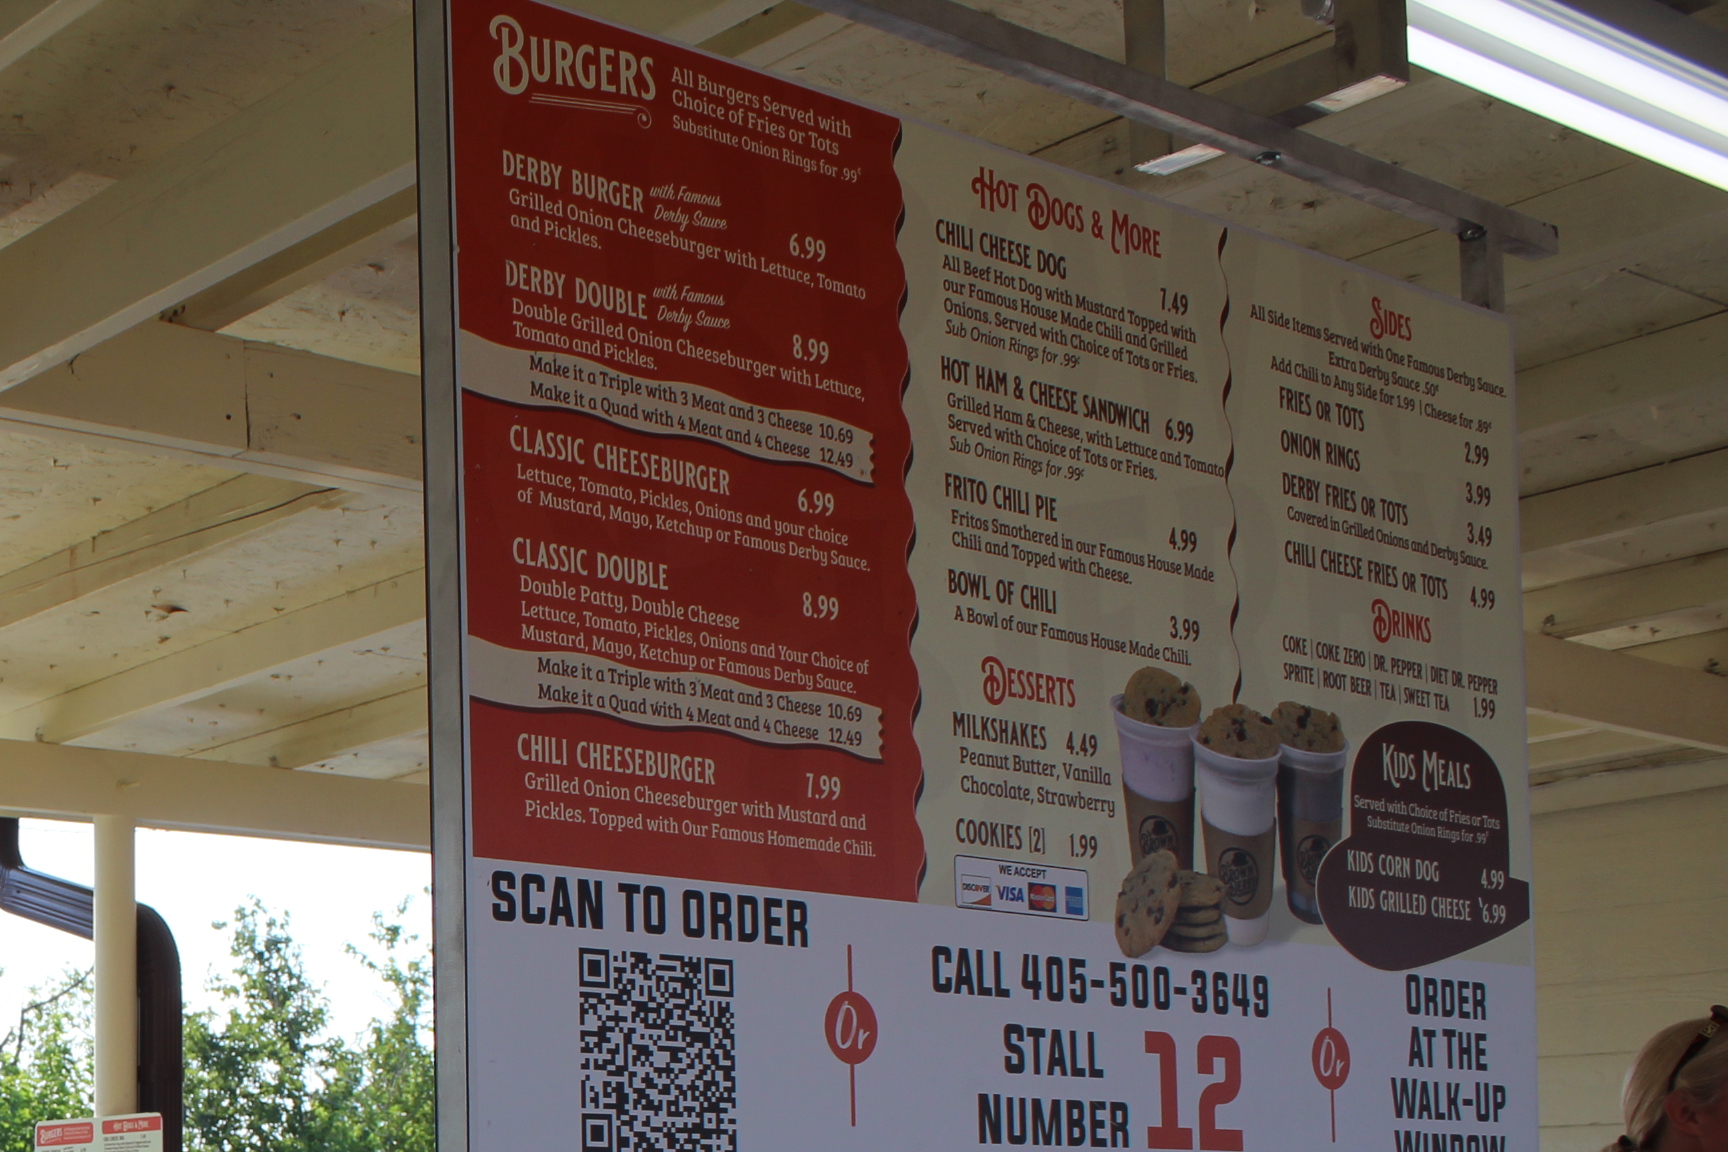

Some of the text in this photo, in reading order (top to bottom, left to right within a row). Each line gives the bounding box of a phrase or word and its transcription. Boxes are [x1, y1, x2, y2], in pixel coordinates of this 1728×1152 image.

[490, 14, 655, 101] BURGERS
[671, 66, 851, 139] All Burgers Served with
[673, 89, 839, 156] Choice of Fries or Tots
[503, 149, 825, 263] DERBY BURGER 6.99
[972, 166, 1161, 259] HOT DOGS & MORE
[508, 188, 866, 300] Grilled Onion Cheeseburger with Lettuce, Tomato
[936, 218, 1189, 316] CHILI CHEESE DOG 7.49
[506, 259, 828, 365] DERBY DOUBLE 8.99
[1370, 296, 1411, 342] SIDES
[941, 355, 1194, 445] HOT HAM & CHEESE SANDWICH 6.99
[1280, 385, 1490, 468] FRIES OR TOTS 2.99
[510, 424, 834, 517] CLASSIC CHEESEBURGER 6.99
[1281, 429, 1491, 508] ONION RINGS 3.99
[945, 472, 1198, 554] FRITO CHILI PIE 4.99
[1283, 471, 1493, 548] DERBY FRIES OR TOTS 3.49
[513, 537, 838, 621] CLASSIC DOUBLE 8.99
[948, 568, 1199, 643] BOWL OF CHILI 3.99
[1285, 539, 1496, 611] CHILI CHEESE FRIES OR TOTS 4.99
[1372, 598, 1431, 644] DRINKS
[981, 655, 1075, 708] DESSERTS
[518, 733, 840, 801] CHILI CHEESEBURGER 7.99
[953, 711, 1097, 758] MILKSHAKES 4.49
[960, 746, 1110, 786] Peanut Butter, Vanilla
[1383, 742, 1470, 792] KIDS MEALS
[961, 775, 1114, 819] Chocolate, Strawberry
[956, 817, 1022, 851] COOKIES
[1069, 833, 1098, 859] 1.99
[1347, 849, 1374, 874] KIDS
[1379, 853, 1410, 878] CORN
[1415, 858, 1439, 883] DOG
[1480, 868, 1505, 890] 4.99
[995, 885, 1025, 903] VISA
[999, 864, 1047, 880] WE ACCEPT
[1348, 885, 1506, 926] KIDS GRILLED CHEESE 6.99
[492, 870, 807, 948] SCAN TO ORDER
[932, 945, 1269, 1019] CALL 405-500-3649
[1406, 973, 1485, 1022] ORDER
[836, 998, 869, 1052] Or
[1004, 1023, 1103, 1079] STALL
[1319, 1034, 1346, 1078] Or
[1408, 1026, 1487, 1072] AT THE
[979, 1091, 1128, 1150] NUMBER
[1391, 1077, 1505, 1123] WALK-UP
